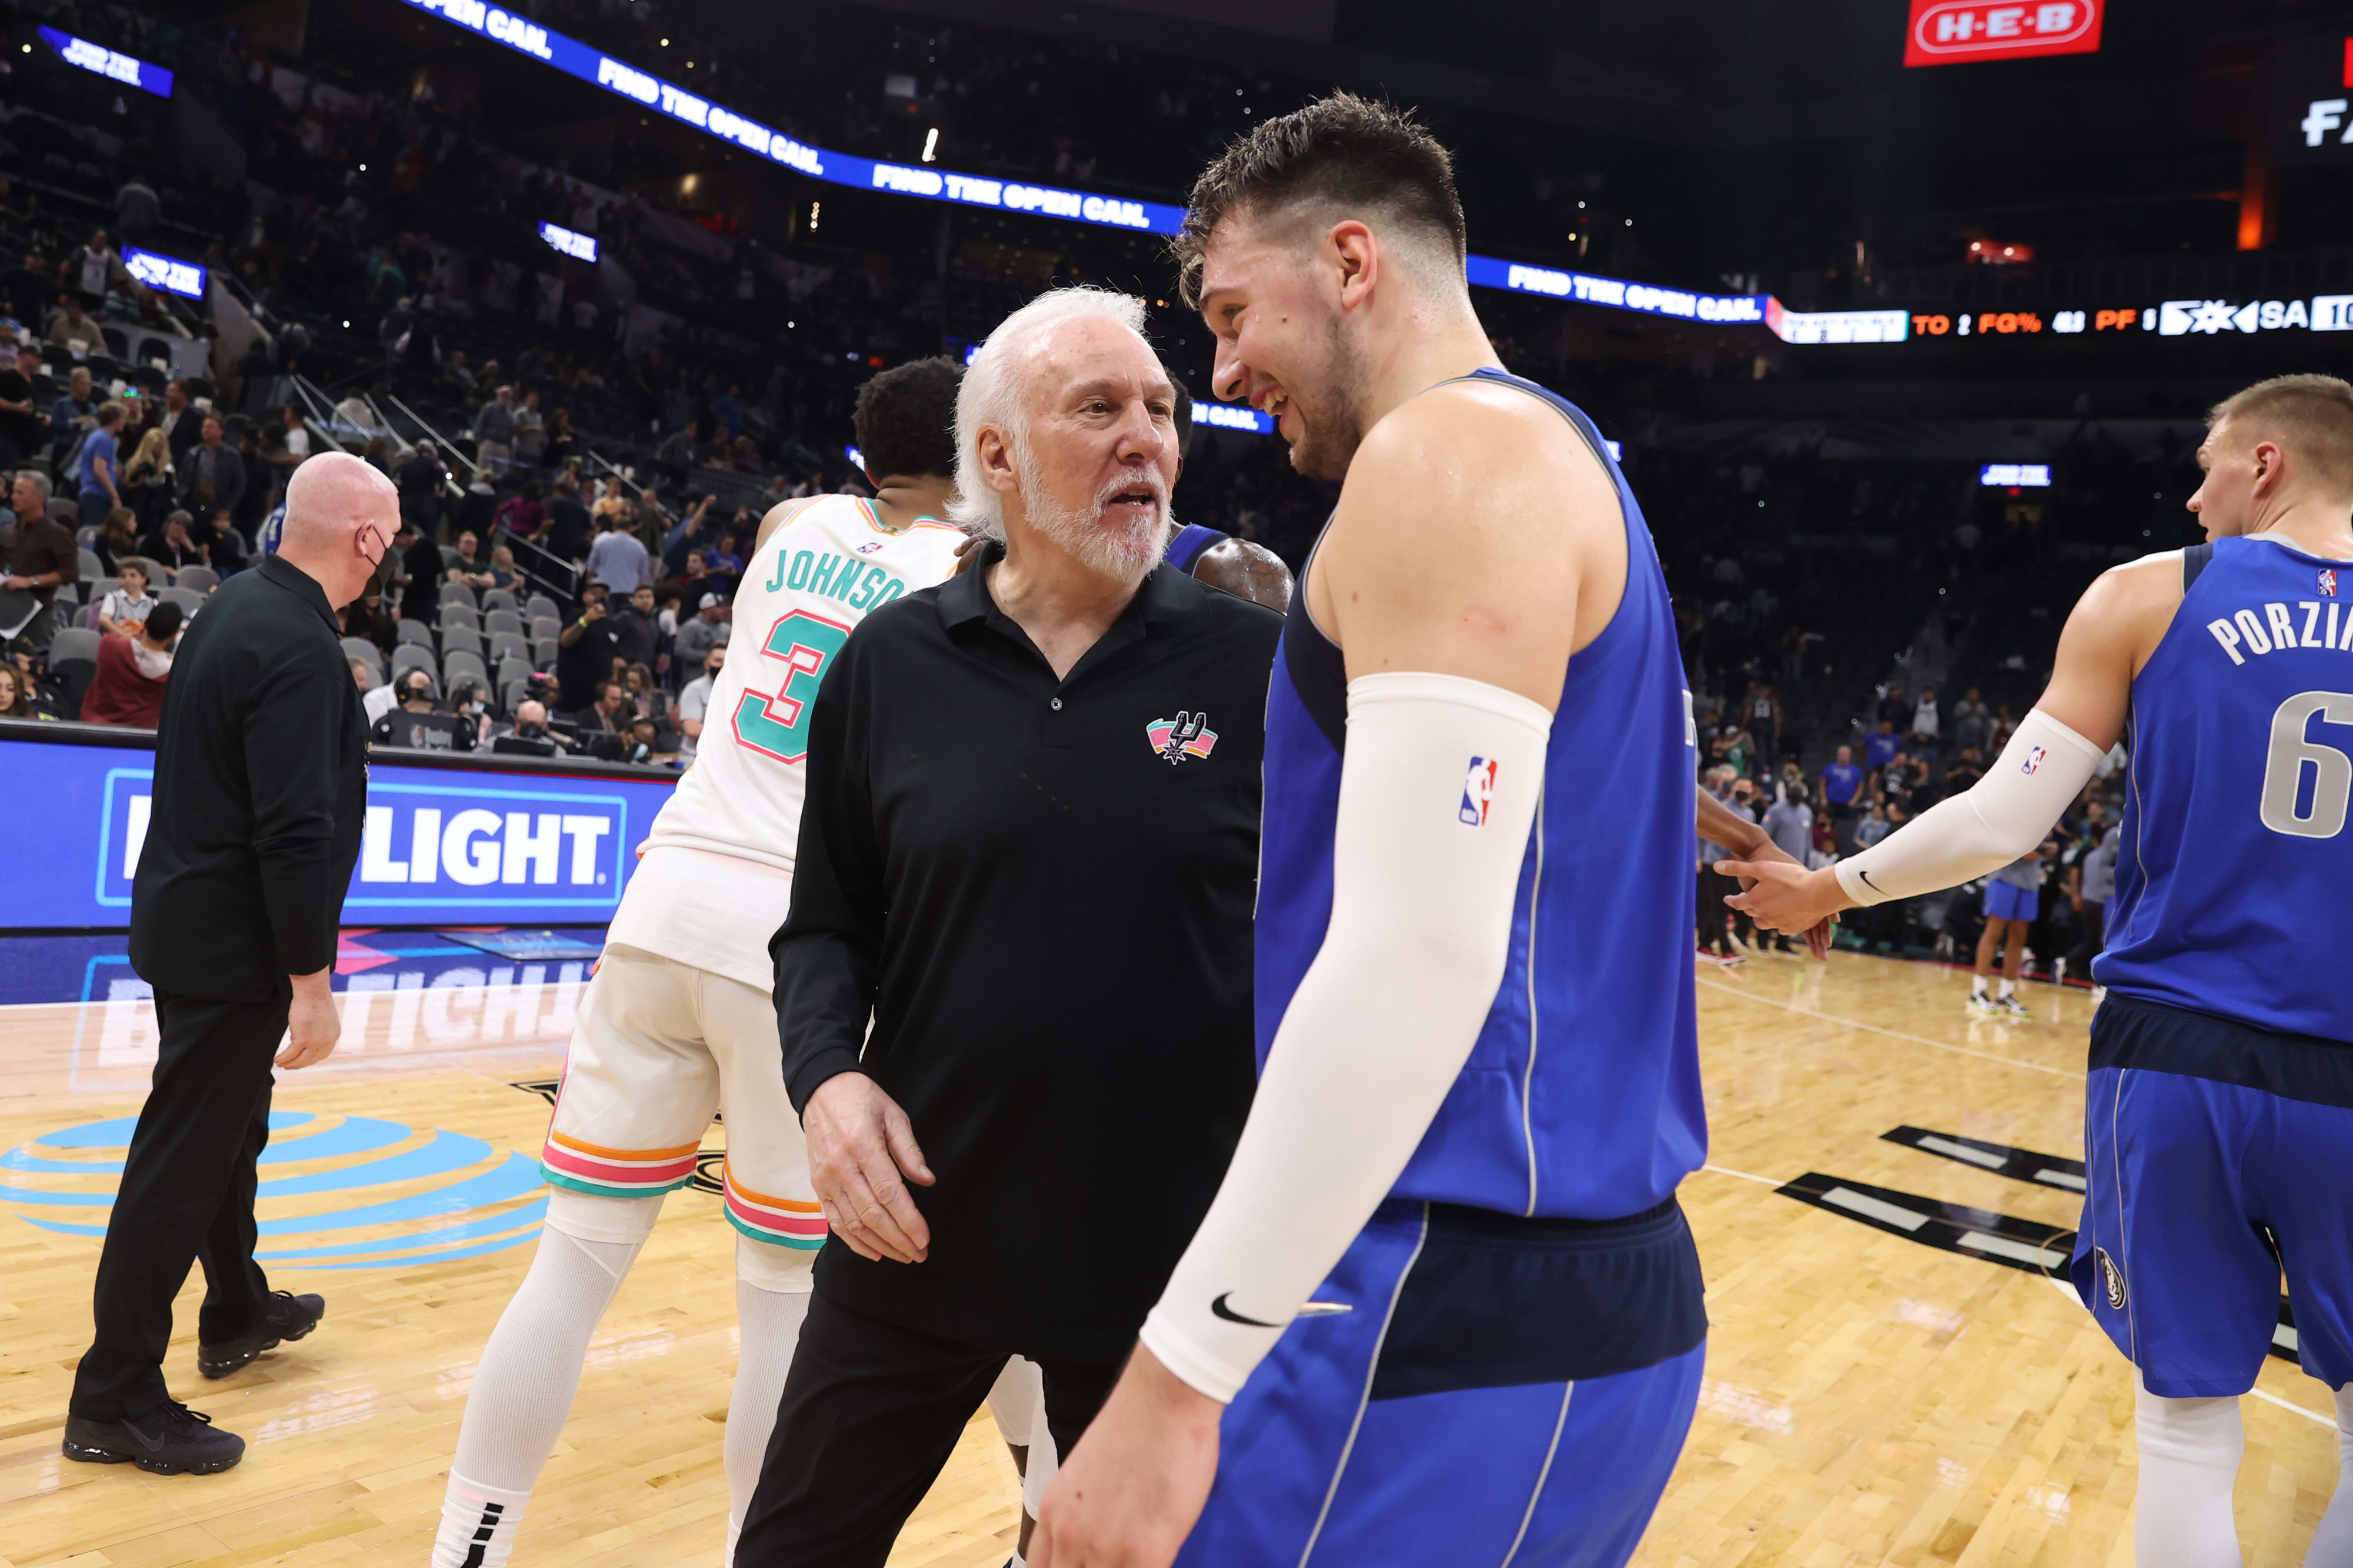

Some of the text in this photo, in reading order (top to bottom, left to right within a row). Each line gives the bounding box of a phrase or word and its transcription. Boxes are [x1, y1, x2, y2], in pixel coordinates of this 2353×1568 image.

[598, 57, 659, 104] FIND
[661, 84, 709, 128] THE
[708, 107, 771, 154] OPEN
[872, 164, 943, 196] FIND
[944, 174, 1002, 206] THE
[1002, 184, 1082, 218] OPEN
[1508, 264, 1572, 296] FIND
[1572, 275, 1625, 305] THE
[1625, 285, 1697, 318] OPEN
[1911, 313, 1950, 336] TO
[1978, 312, 2042, 335] FG%
[2095, 309, 2137, 331] PF
[2259, 299, 2309, 330] SA
[766, 549, 915, 614] JOHNSO
[731, 608, 853, 765] 3
[2259, 690, 2353, 839] 6
[361, 806, 611, 886] LIGHT
